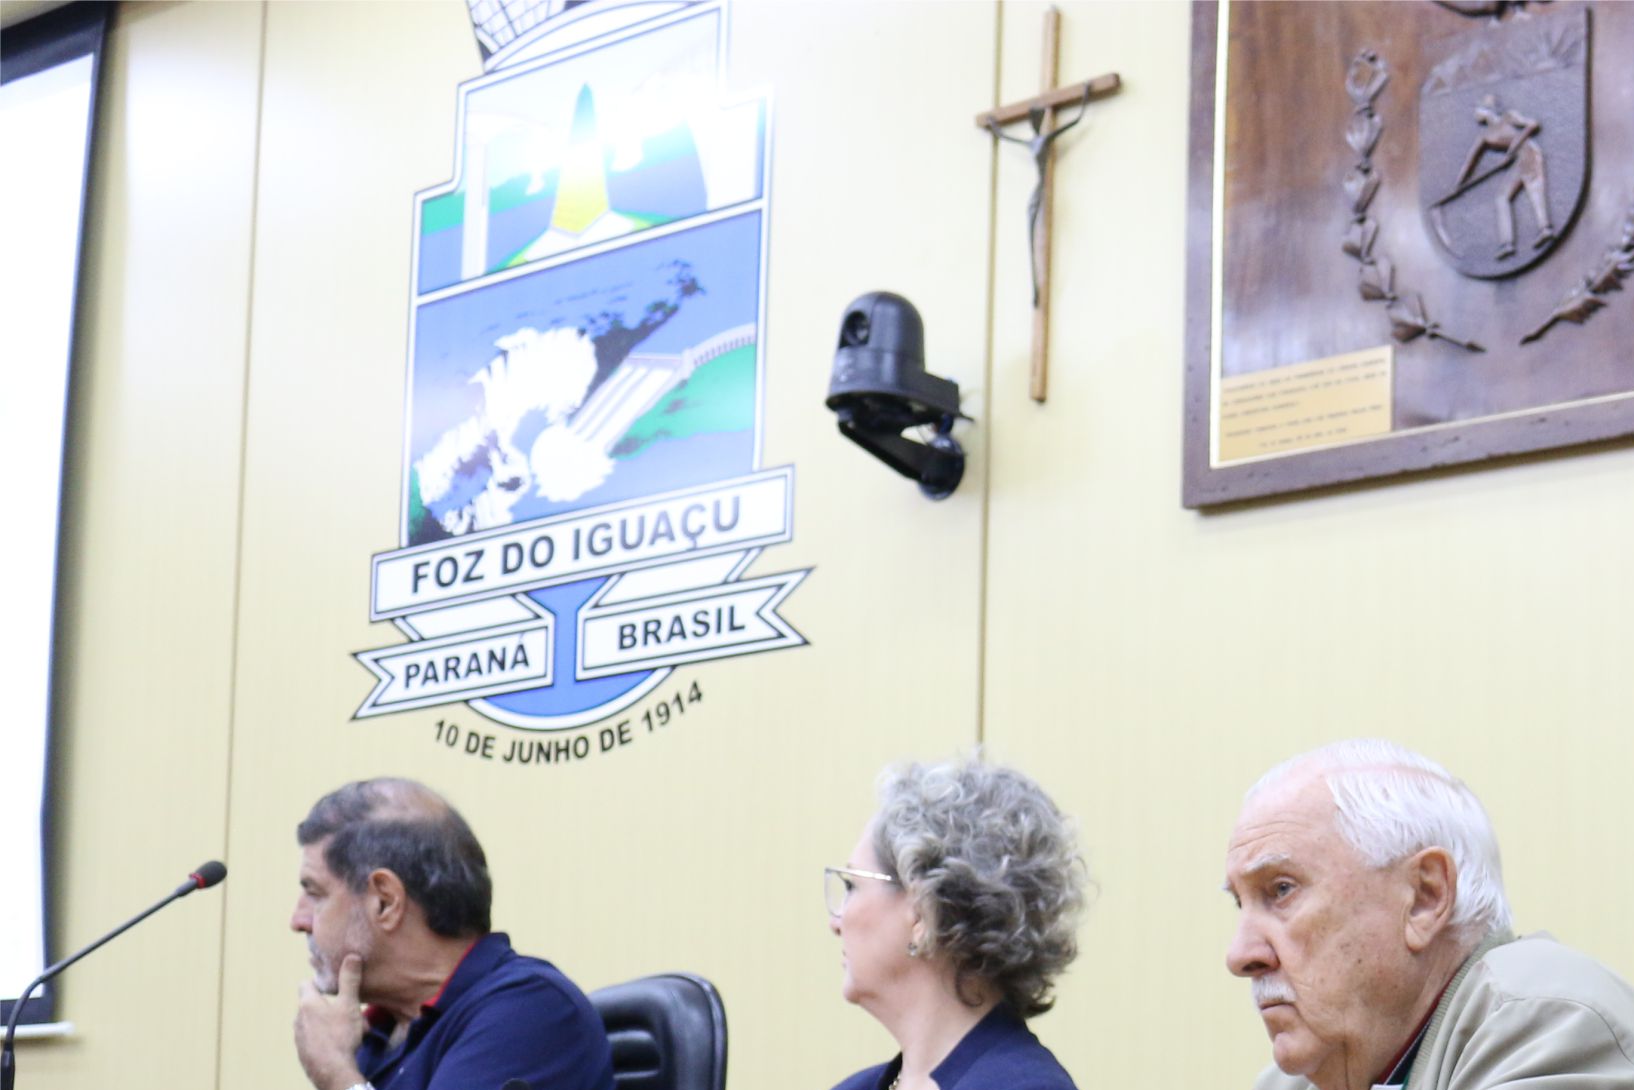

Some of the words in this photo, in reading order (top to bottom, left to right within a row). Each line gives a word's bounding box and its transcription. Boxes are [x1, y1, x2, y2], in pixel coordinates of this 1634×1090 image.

[413, 550, 484, 593] FOZ
[502, 536, 554, 575] DO
[573, 496, 741, 560] IGUAÇU
[404, 632, 529, 689] PARANÁ
[618, 605, 746, 650] BRASIL
[434, 719, 458, 747] 10
[465, 732, 496, 758] DE
[503, 736, 590, 763] JUNHO
[600, 720, 632, 752] DE
[641, 680, 703, 732] 1914
